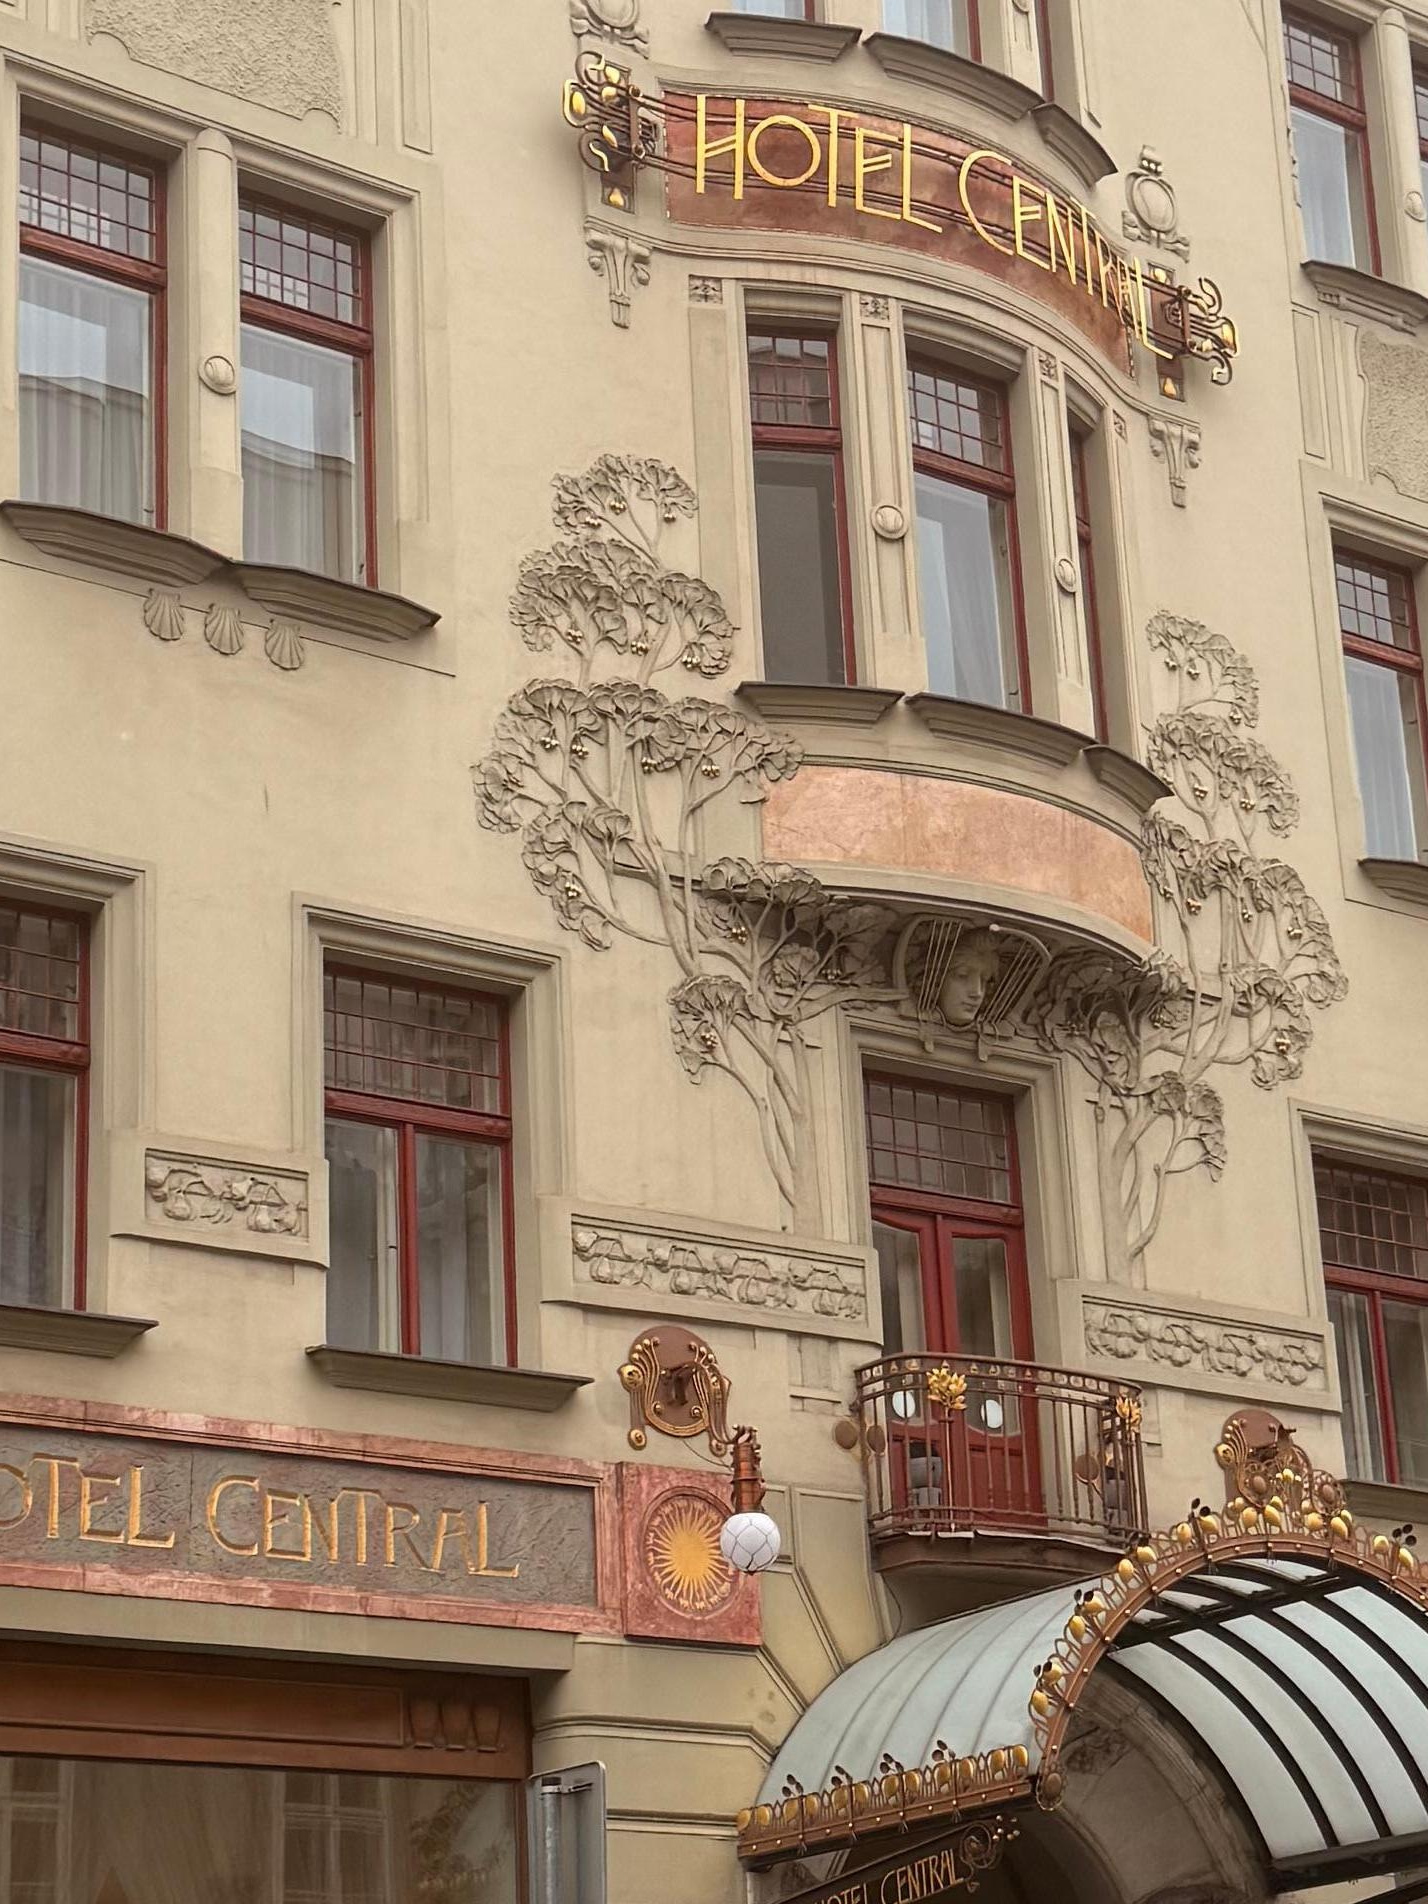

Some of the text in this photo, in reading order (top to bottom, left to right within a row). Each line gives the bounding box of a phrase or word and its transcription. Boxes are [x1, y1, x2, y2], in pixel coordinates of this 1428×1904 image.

[696, 94, 1173, 360] HOTEL CENTRAL
[206, 1474, 520, 1579] CENTRAL
